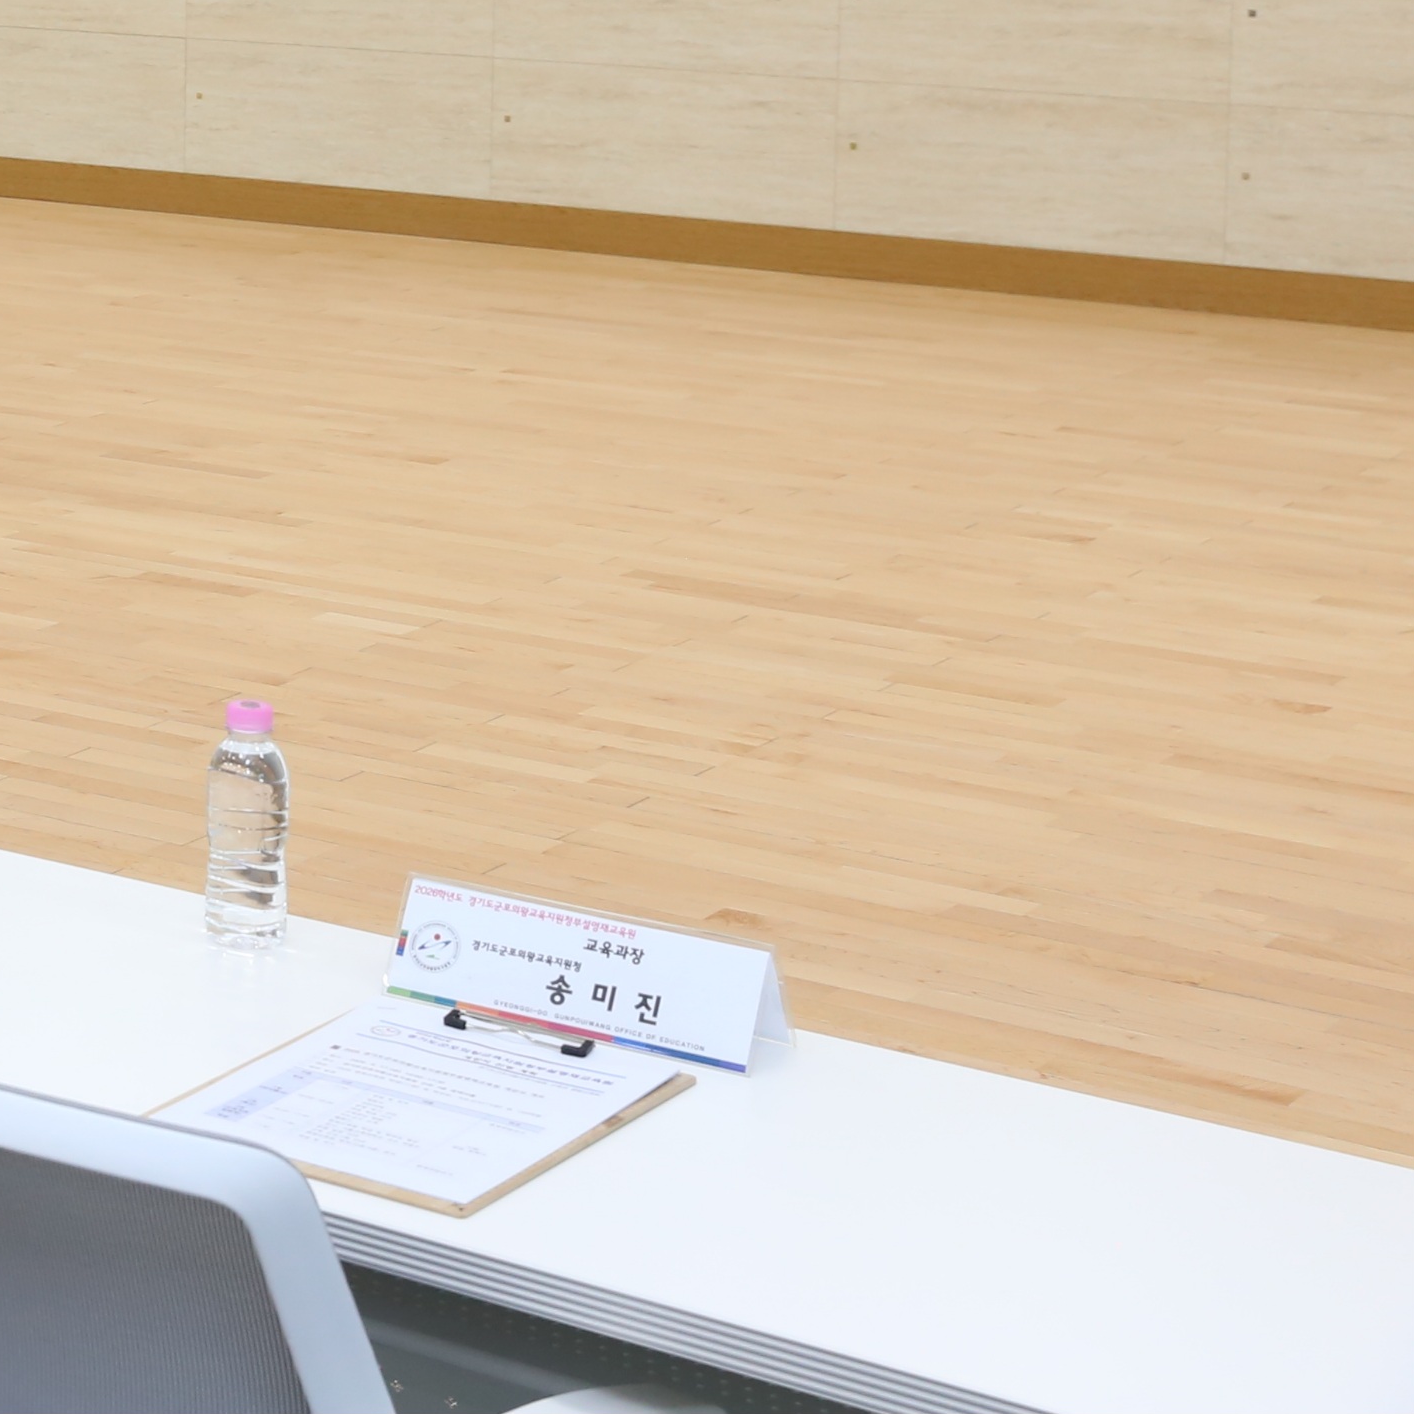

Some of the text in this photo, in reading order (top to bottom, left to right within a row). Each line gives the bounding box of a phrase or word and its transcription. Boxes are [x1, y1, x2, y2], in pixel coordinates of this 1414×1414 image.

[414, 885, 464, 903] 2026학년도
[471, 939, 583, 973] 경기도군포의왕교육지원청
[583, 937, 646, 966] 교육과장
[614, 1024, 644, 1039] OFFICE
[646, 1033, 657, 1042] OF
[659, 1035, 706, 1053] EDUCATION
